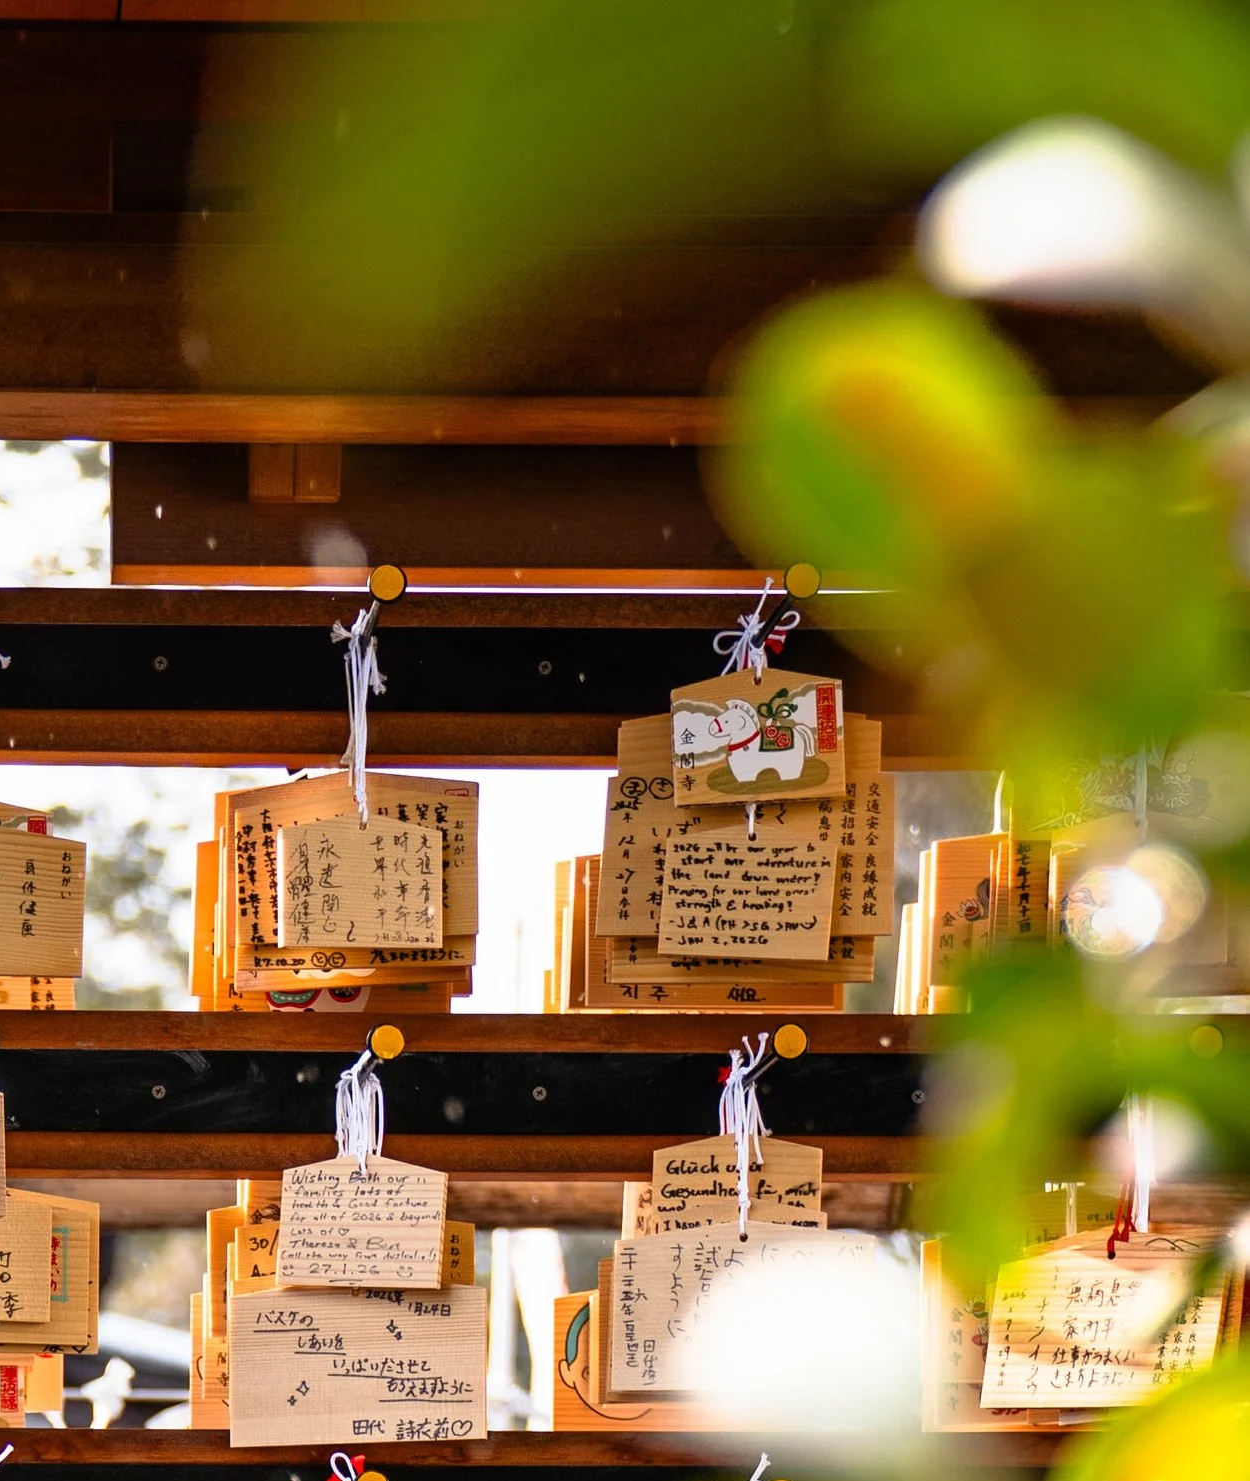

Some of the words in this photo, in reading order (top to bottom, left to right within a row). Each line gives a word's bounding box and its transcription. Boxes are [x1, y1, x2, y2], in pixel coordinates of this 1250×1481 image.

[680, 730, 695, 791] 金閣寺
[865, 783, 880, 846] 交通安全
[454, 821, 464, 867] おねがい
[62, 853, 70, 899] おねがい
[862, 854, 878, 916] 良縁成就
[292, 1171, 340, 1188] Wishing
[257, 1311, 313, 1327] バスケの
